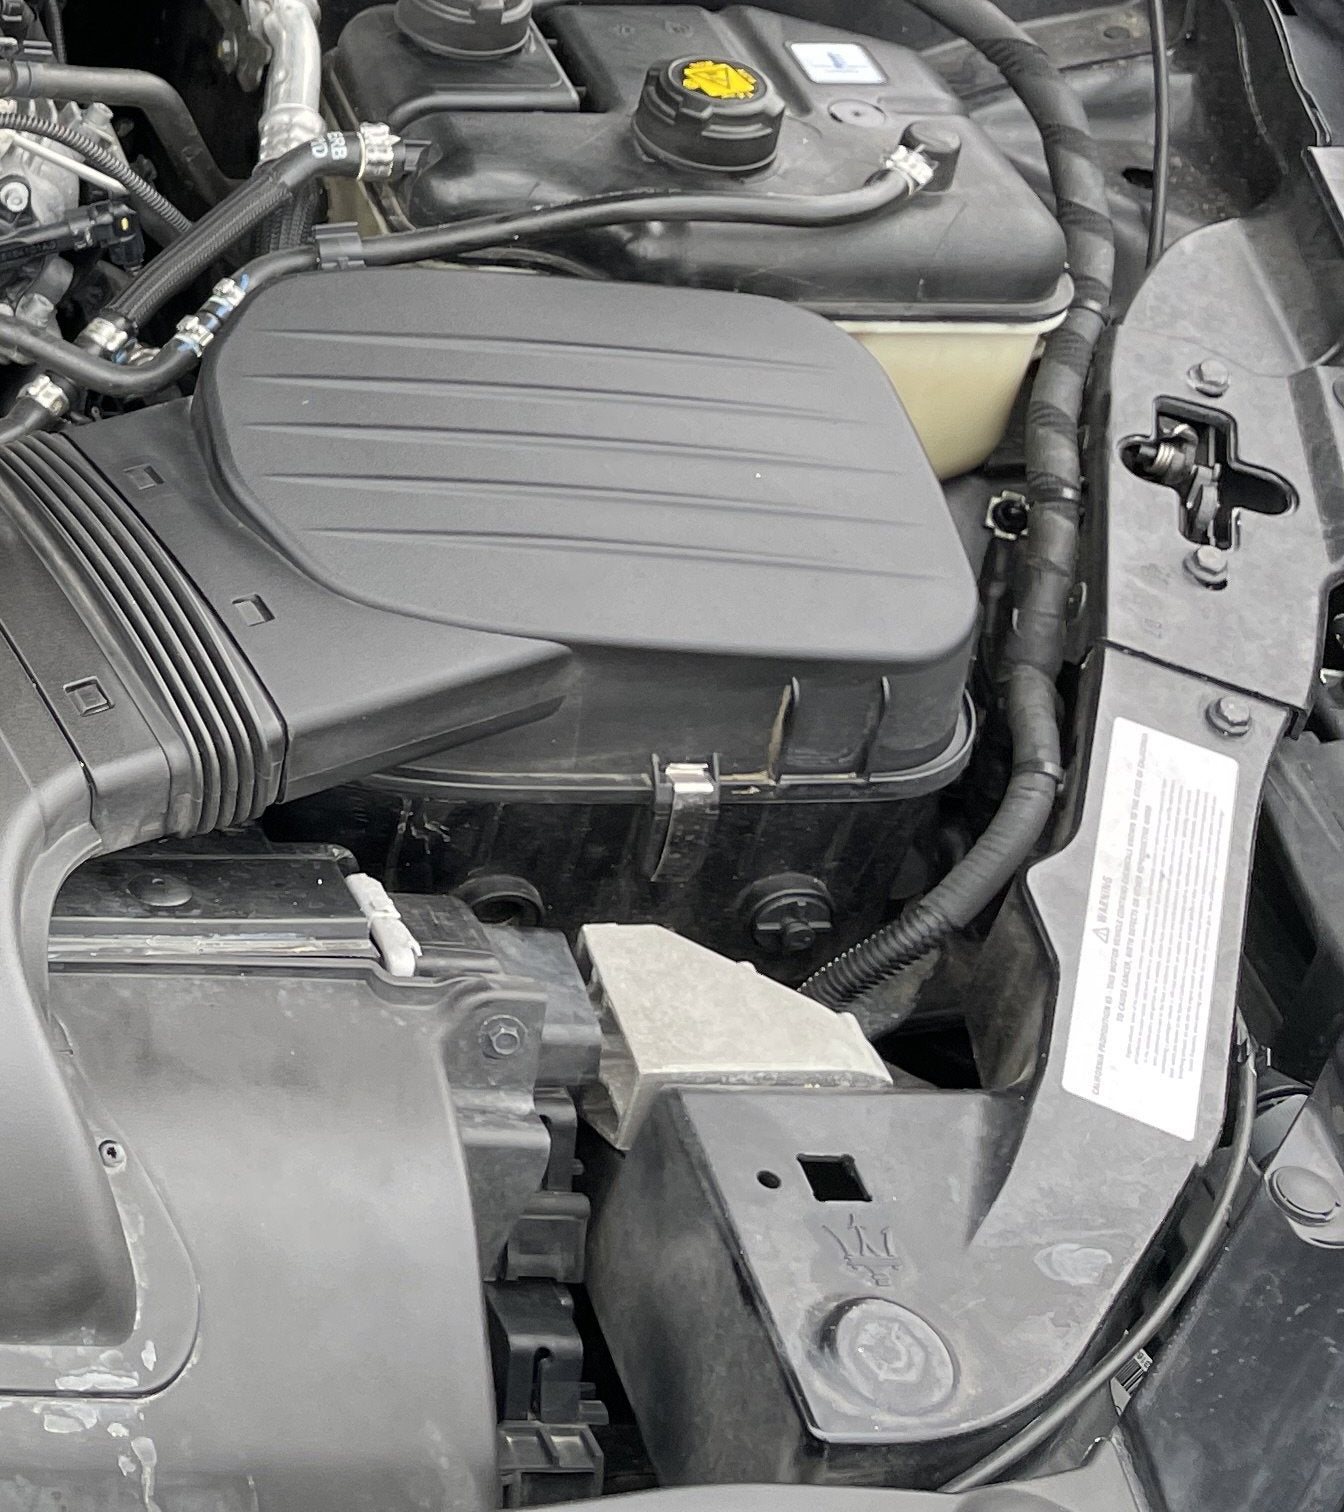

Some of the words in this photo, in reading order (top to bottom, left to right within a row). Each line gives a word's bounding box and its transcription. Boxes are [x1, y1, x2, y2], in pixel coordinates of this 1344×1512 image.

[1097, 875, 1112, 923] WARNING
[1092, 1053, 1104, 1096] CALIFORNIA
[1098, 1005, 1110, 1052] PROPOSITION
